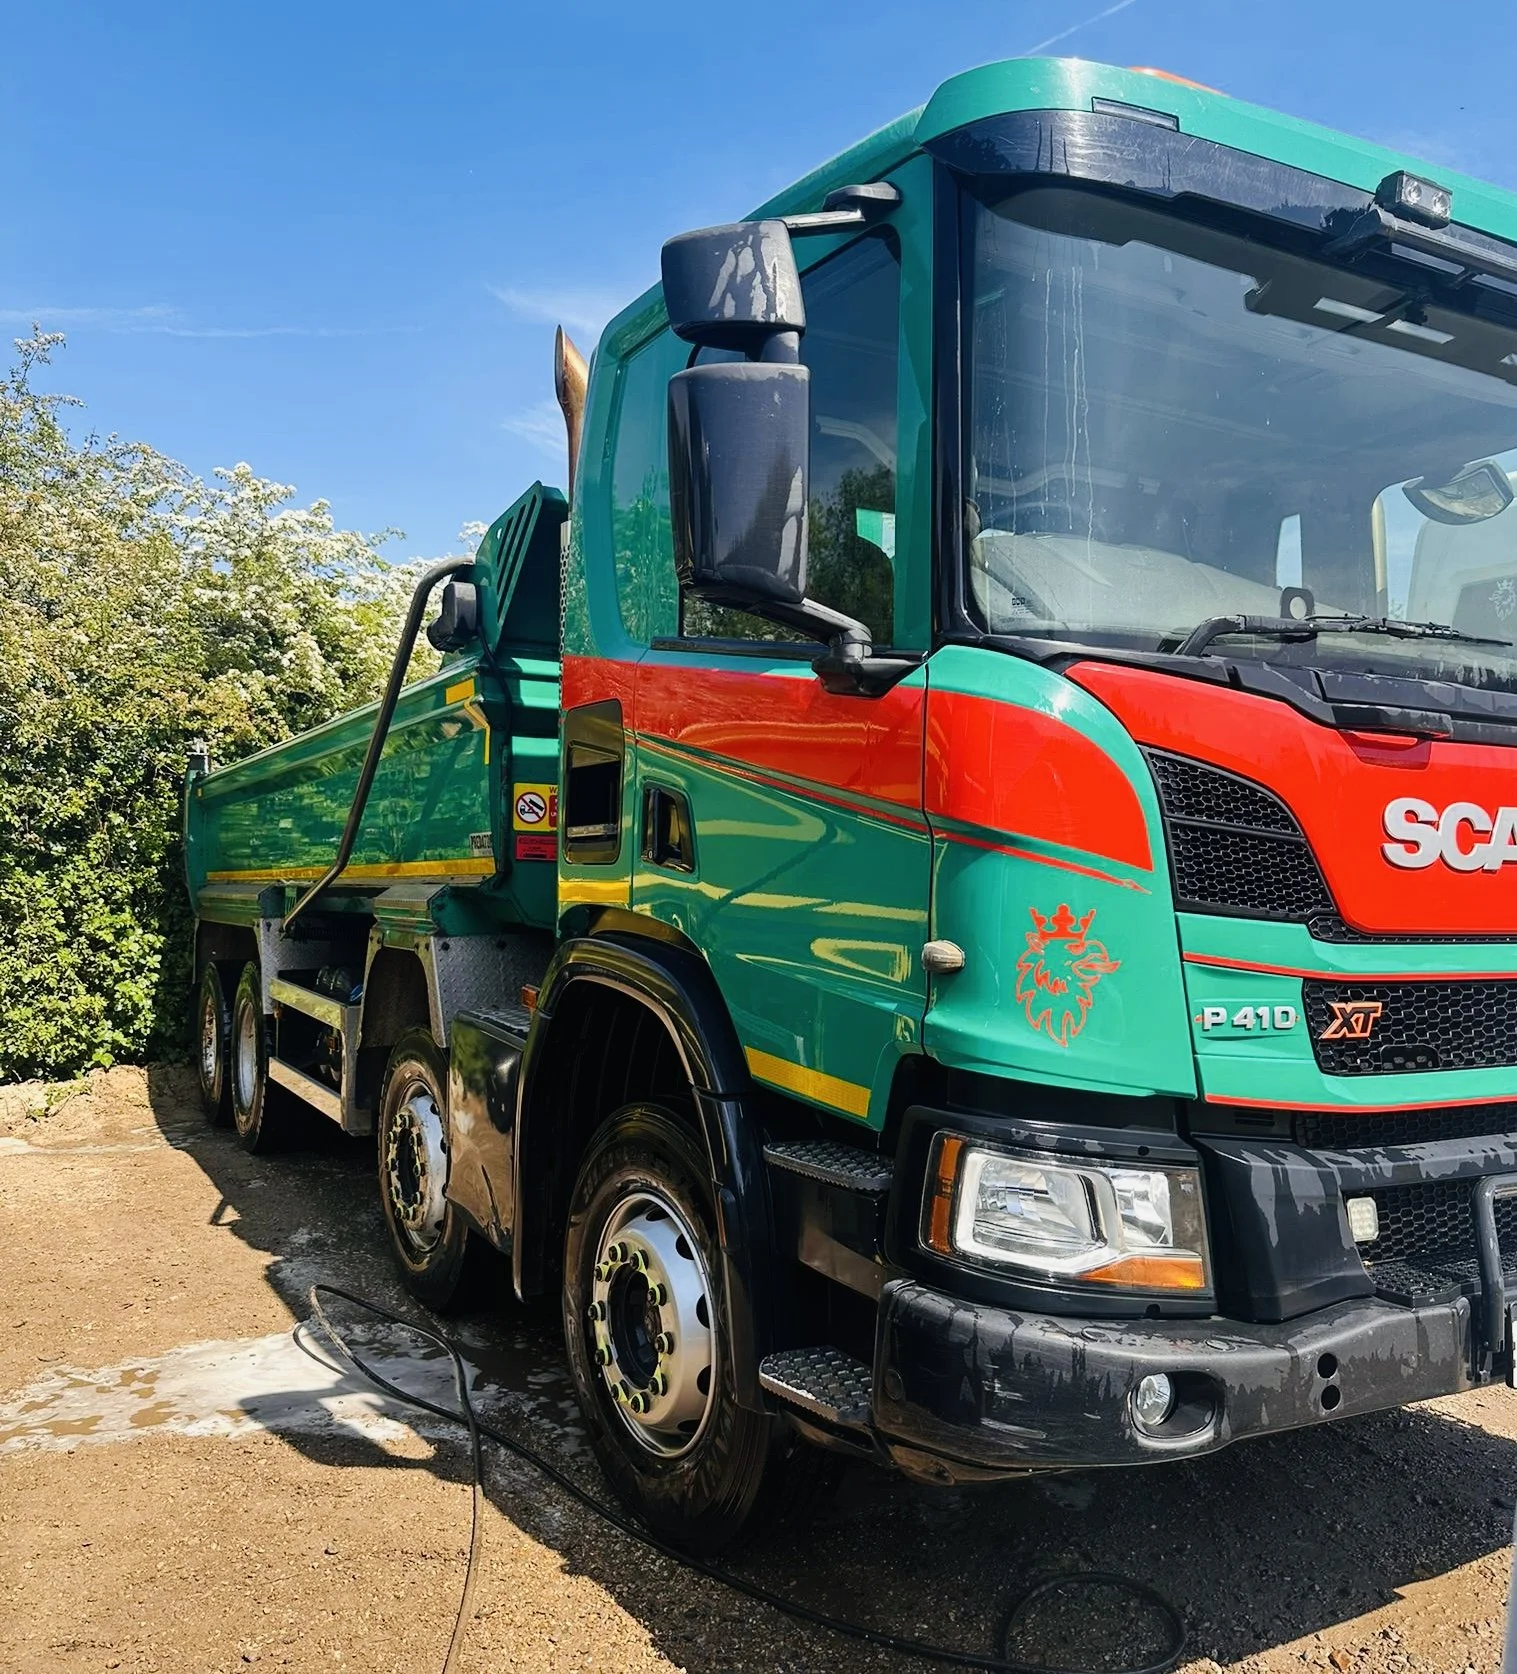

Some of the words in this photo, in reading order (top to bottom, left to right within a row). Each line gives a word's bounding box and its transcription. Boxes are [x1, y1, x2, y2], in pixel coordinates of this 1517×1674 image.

[1202, 1006, 1227, 1031] P
[1231, 1006, 1296, 1030] 410
[1320, 1001, 1383, 1041] XT
